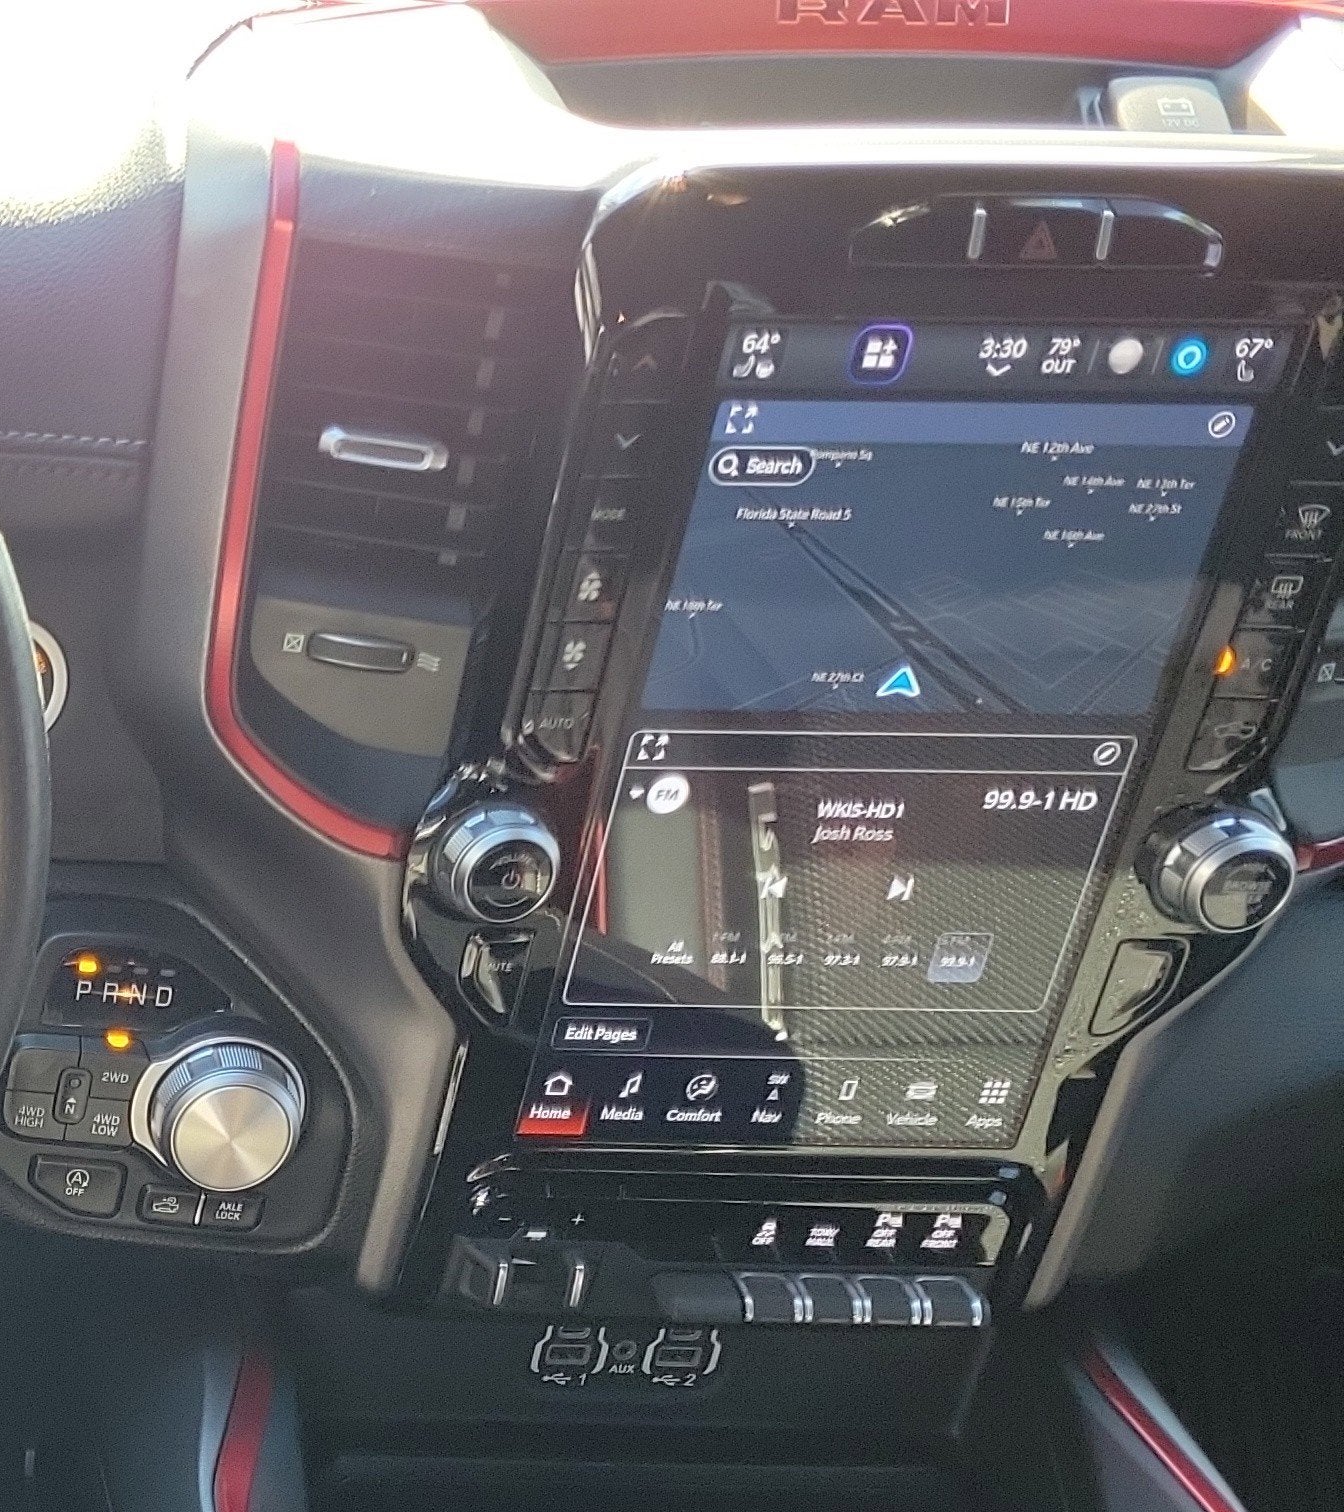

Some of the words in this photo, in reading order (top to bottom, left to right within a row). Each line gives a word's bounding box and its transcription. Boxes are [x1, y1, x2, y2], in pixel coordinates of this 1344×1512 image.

[776, 0, 1011, 25] RAM
[978, 337, 1028, 360] 3:30
[1049, 337, 1081, 357] 79°
[1235, 337, 1274, 358] 67°
[1041, 358, 1075, 375] OUT
[744, 456, 803, 476] Search
[735, 507, 778, 521] Florida
[655, 787, 681, 801] FM
[982, 790, 1055, 812] 99.9-1
[1059, 790, 1098, 812] HD
[817, 801, 905, 820] WKIS-HD1
[811, 824, 850, 844] Josh
[853, 825, 894, 843] Ross
[564, 1026, 592, 1042] Edit
[594, 1027, 638, 1043] Pages
[101, 1072, 130, 1085] 2WD
[18, 1106, 46, 1119] 4WD
[63, 1103, 76, 1116] N
[528, 1105, 571, 1121] Home
[600, 1106, 643, 1122] Media
[666, 1107, 723, 1124] Comfort
[751, 1108, 783, 1124] Nav
[14, 1115, 45, 1129] HIGH
[92, 1112, 121, 1127] 4WD
[814, 1112, 863, 1127] Phone
[886, 1112, 938, 1128] Vehicle
[965, 1113, 1004, 1129] Apps
[91, 1124, 119, 1138] LOW
[64, 1187, 86, 1198] OFF
[218, 1201, 244, 1213] AXLE
[215, 1209, 242, 1222] LOCK
[609, 1363, 635, 1375] AUX
[578, 1372, 588, 1387] 1
[683, 1372, 697, 1387] 2
